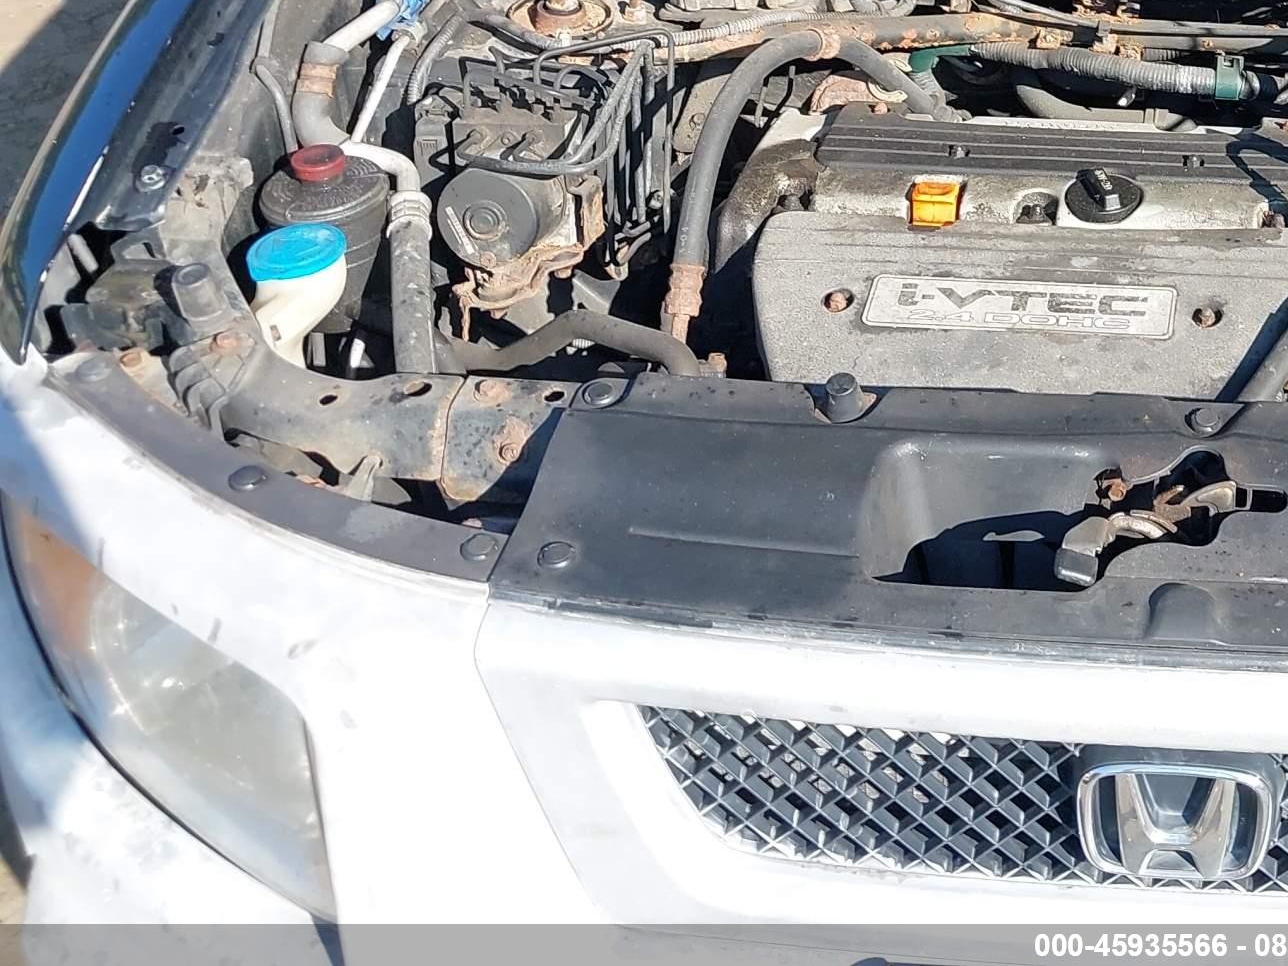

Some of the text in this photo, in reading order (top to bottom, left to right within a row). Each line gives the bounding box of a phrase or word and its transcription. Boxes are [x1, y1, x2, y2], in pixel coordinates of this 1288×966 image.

[898, 282, 1149, 317] i-VTEC
[907, 309, 1132, 330] 2.4 DOHC
